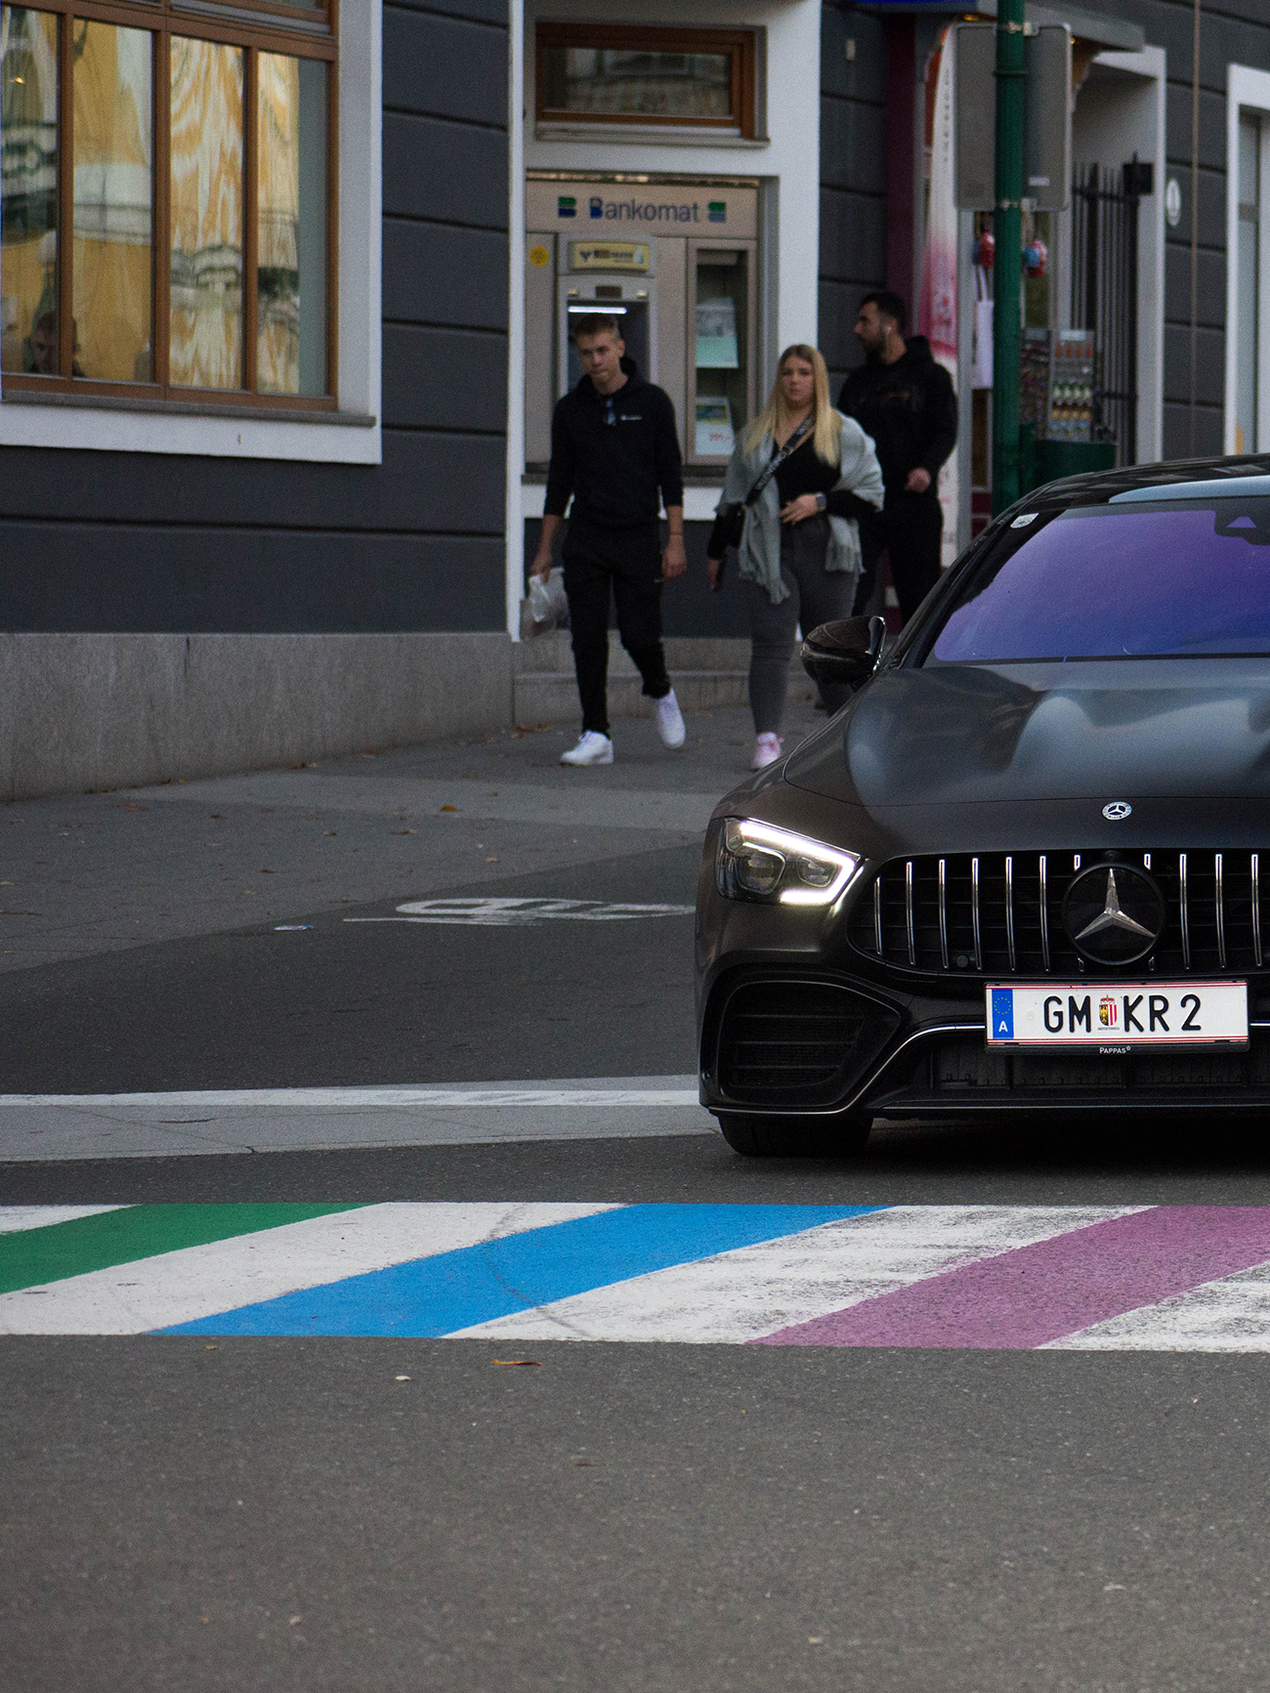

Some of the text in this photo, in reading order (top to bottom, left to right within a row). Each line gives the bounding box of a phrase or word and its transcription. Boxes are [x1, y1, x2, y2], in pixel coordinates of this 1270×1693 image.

[589, 196, 700, 223] Bankomat
[1043, 993, 1202, 1033] GM KR 2
[998, 1020, 1008, 1033] A
[1099, 1046, 1127, 1054] PAPPAS
